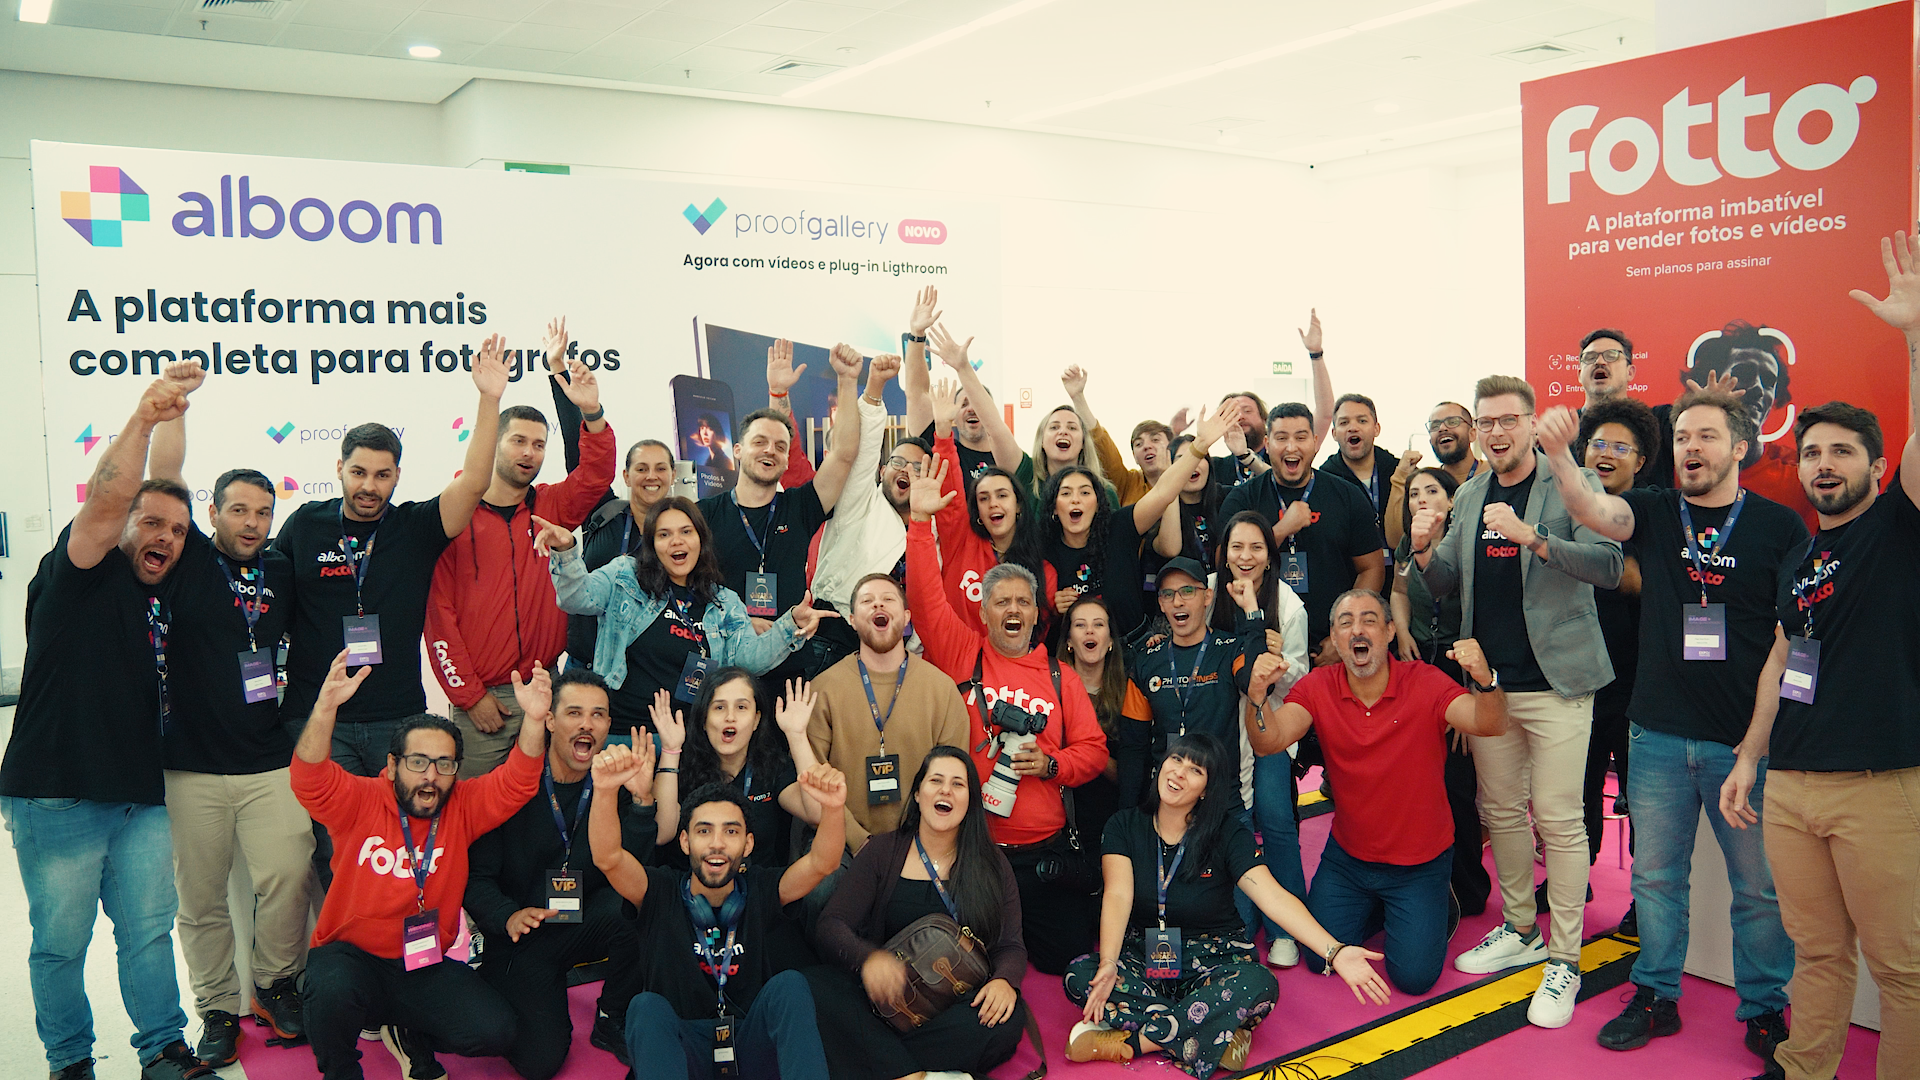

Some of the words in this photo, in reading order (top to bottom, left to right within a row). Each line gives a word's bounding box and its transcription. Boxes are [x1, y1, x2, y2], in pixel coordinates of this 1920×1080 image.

[1547, 75, 1878, 204] fotto
[172, 174, 442, 245] alboom
[1585, 215, 1600, 232] A
[1605, 204, 1713, 234] plataforma
[1720, 188, 1823, 218] imbatível
[735, 210, 889, 244] proofgallery
[904, 225, 941, 239] NOVO
[1568, 240, 1609, 260] para
[1615, 230, 1684, 251] vender
[1690, 225, 1743, 244] fotos
[1750, 223, 1763, 238] e
[1769, 214, 1847, 236] vídeos
[683, 254, 729, 271] Agora
[732, 257, 765, 269] com
[768, 255, 815, 270] vídeos
[818, 261, 826, 270] e
[829, 258, 879, 275] plug-in
[882, 260, 948, 277] Ligthroom
[1626, 265, 1651, 277] Sem
[1654, 262, 1693, 277] planos
[1696, 259, 1723, 274] para
[1726, 255, 1772, 269] assinar
[67, 289, 102, 322] A
[115, 288, 375, 334] plataforma
[387, 292, 487, 325] mais
[310, 348, 410, 385] para
[420, 341, 621, 382] fotgrfos
[303, 481, 333, 495] crm
[872, 764, 894, 775] VIP
[552, 881, 577, 892] VIP
[716, 1029, 730, 1042] VIP
